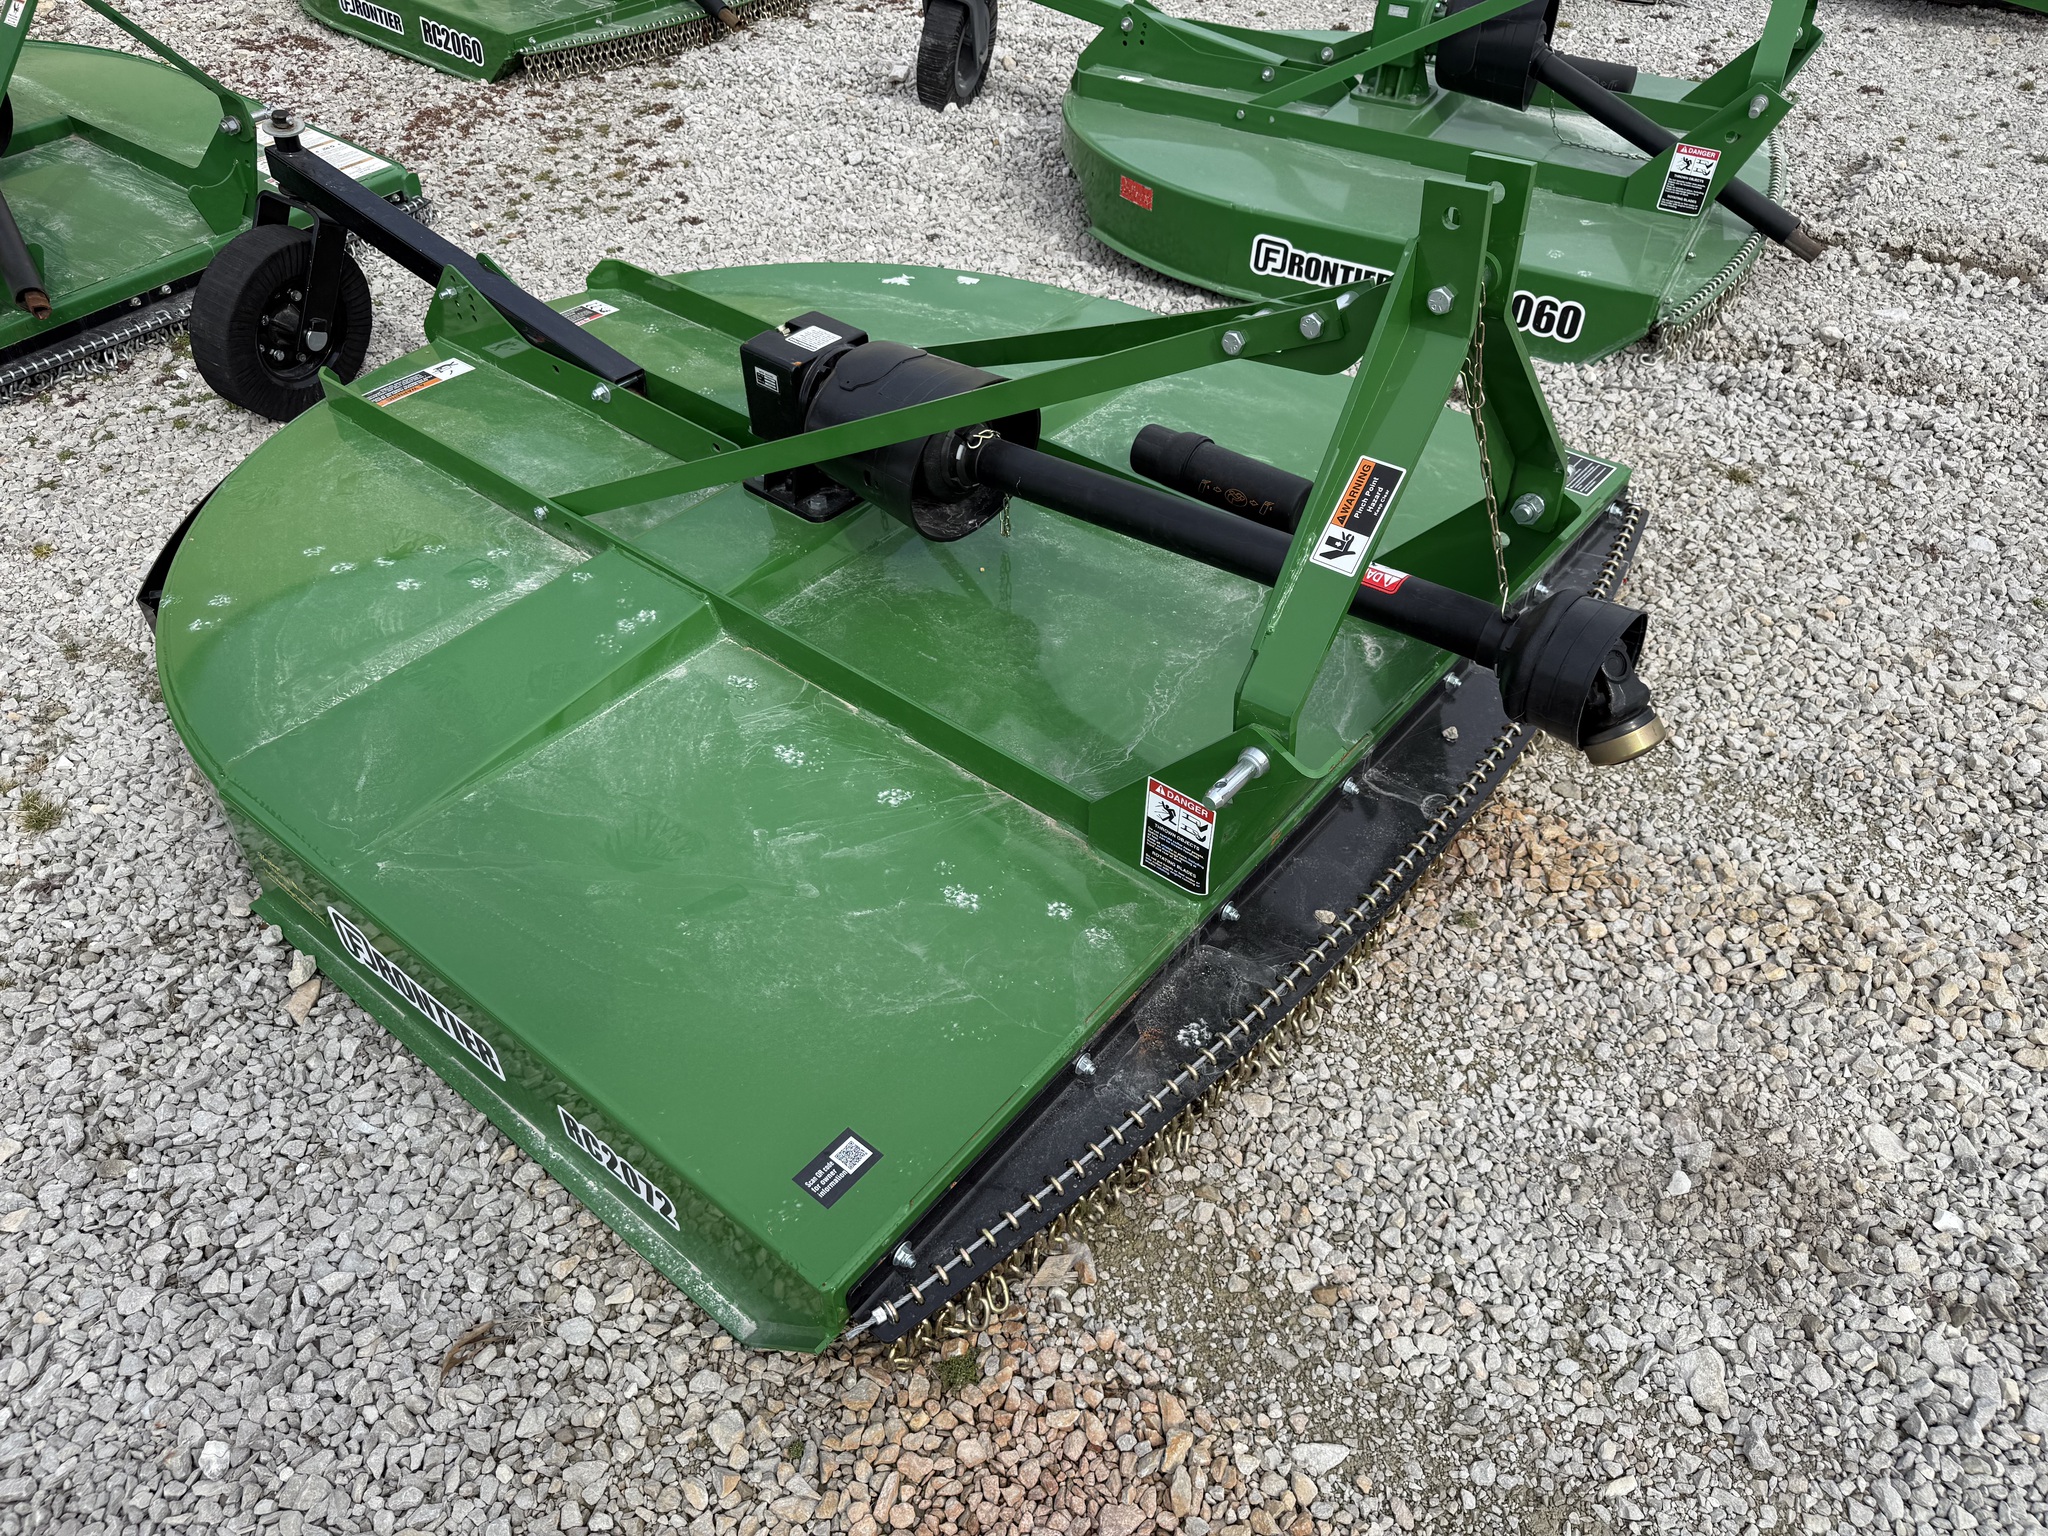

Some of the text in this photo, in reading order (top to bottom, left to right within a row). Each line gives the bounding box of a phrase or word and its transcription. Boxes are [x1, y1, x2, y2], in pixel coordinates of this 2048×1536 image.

[421, 19, 483, 65] RC2060
[1687, 147, 1716, 159] DANGER
[1512, 294, 1582, 340] 060
[1341, 463, 1372, 516] WARNING
[1354, 477, 1380, 519] Pinch Point
[1367, 487, 1384, 513] Hazard
[1374, 489, 1390, 517] Keep Clear
[1166, 790, 1209, 819] DANGER
[1155, 823, 1177, 839] THROWN
[1177, 835, 1200, 852] OBJECTS
[1176, 864, 1197, 879] BLADES
[332, 909, 502, 1077] FRONTIER
[561, 1110, 678, 1227] RC2072
[804, 1161, 835, 1188] Scan QR code
[811, 1168, 838, 1193] for owner
[817, 1170, 848, 1198] information
